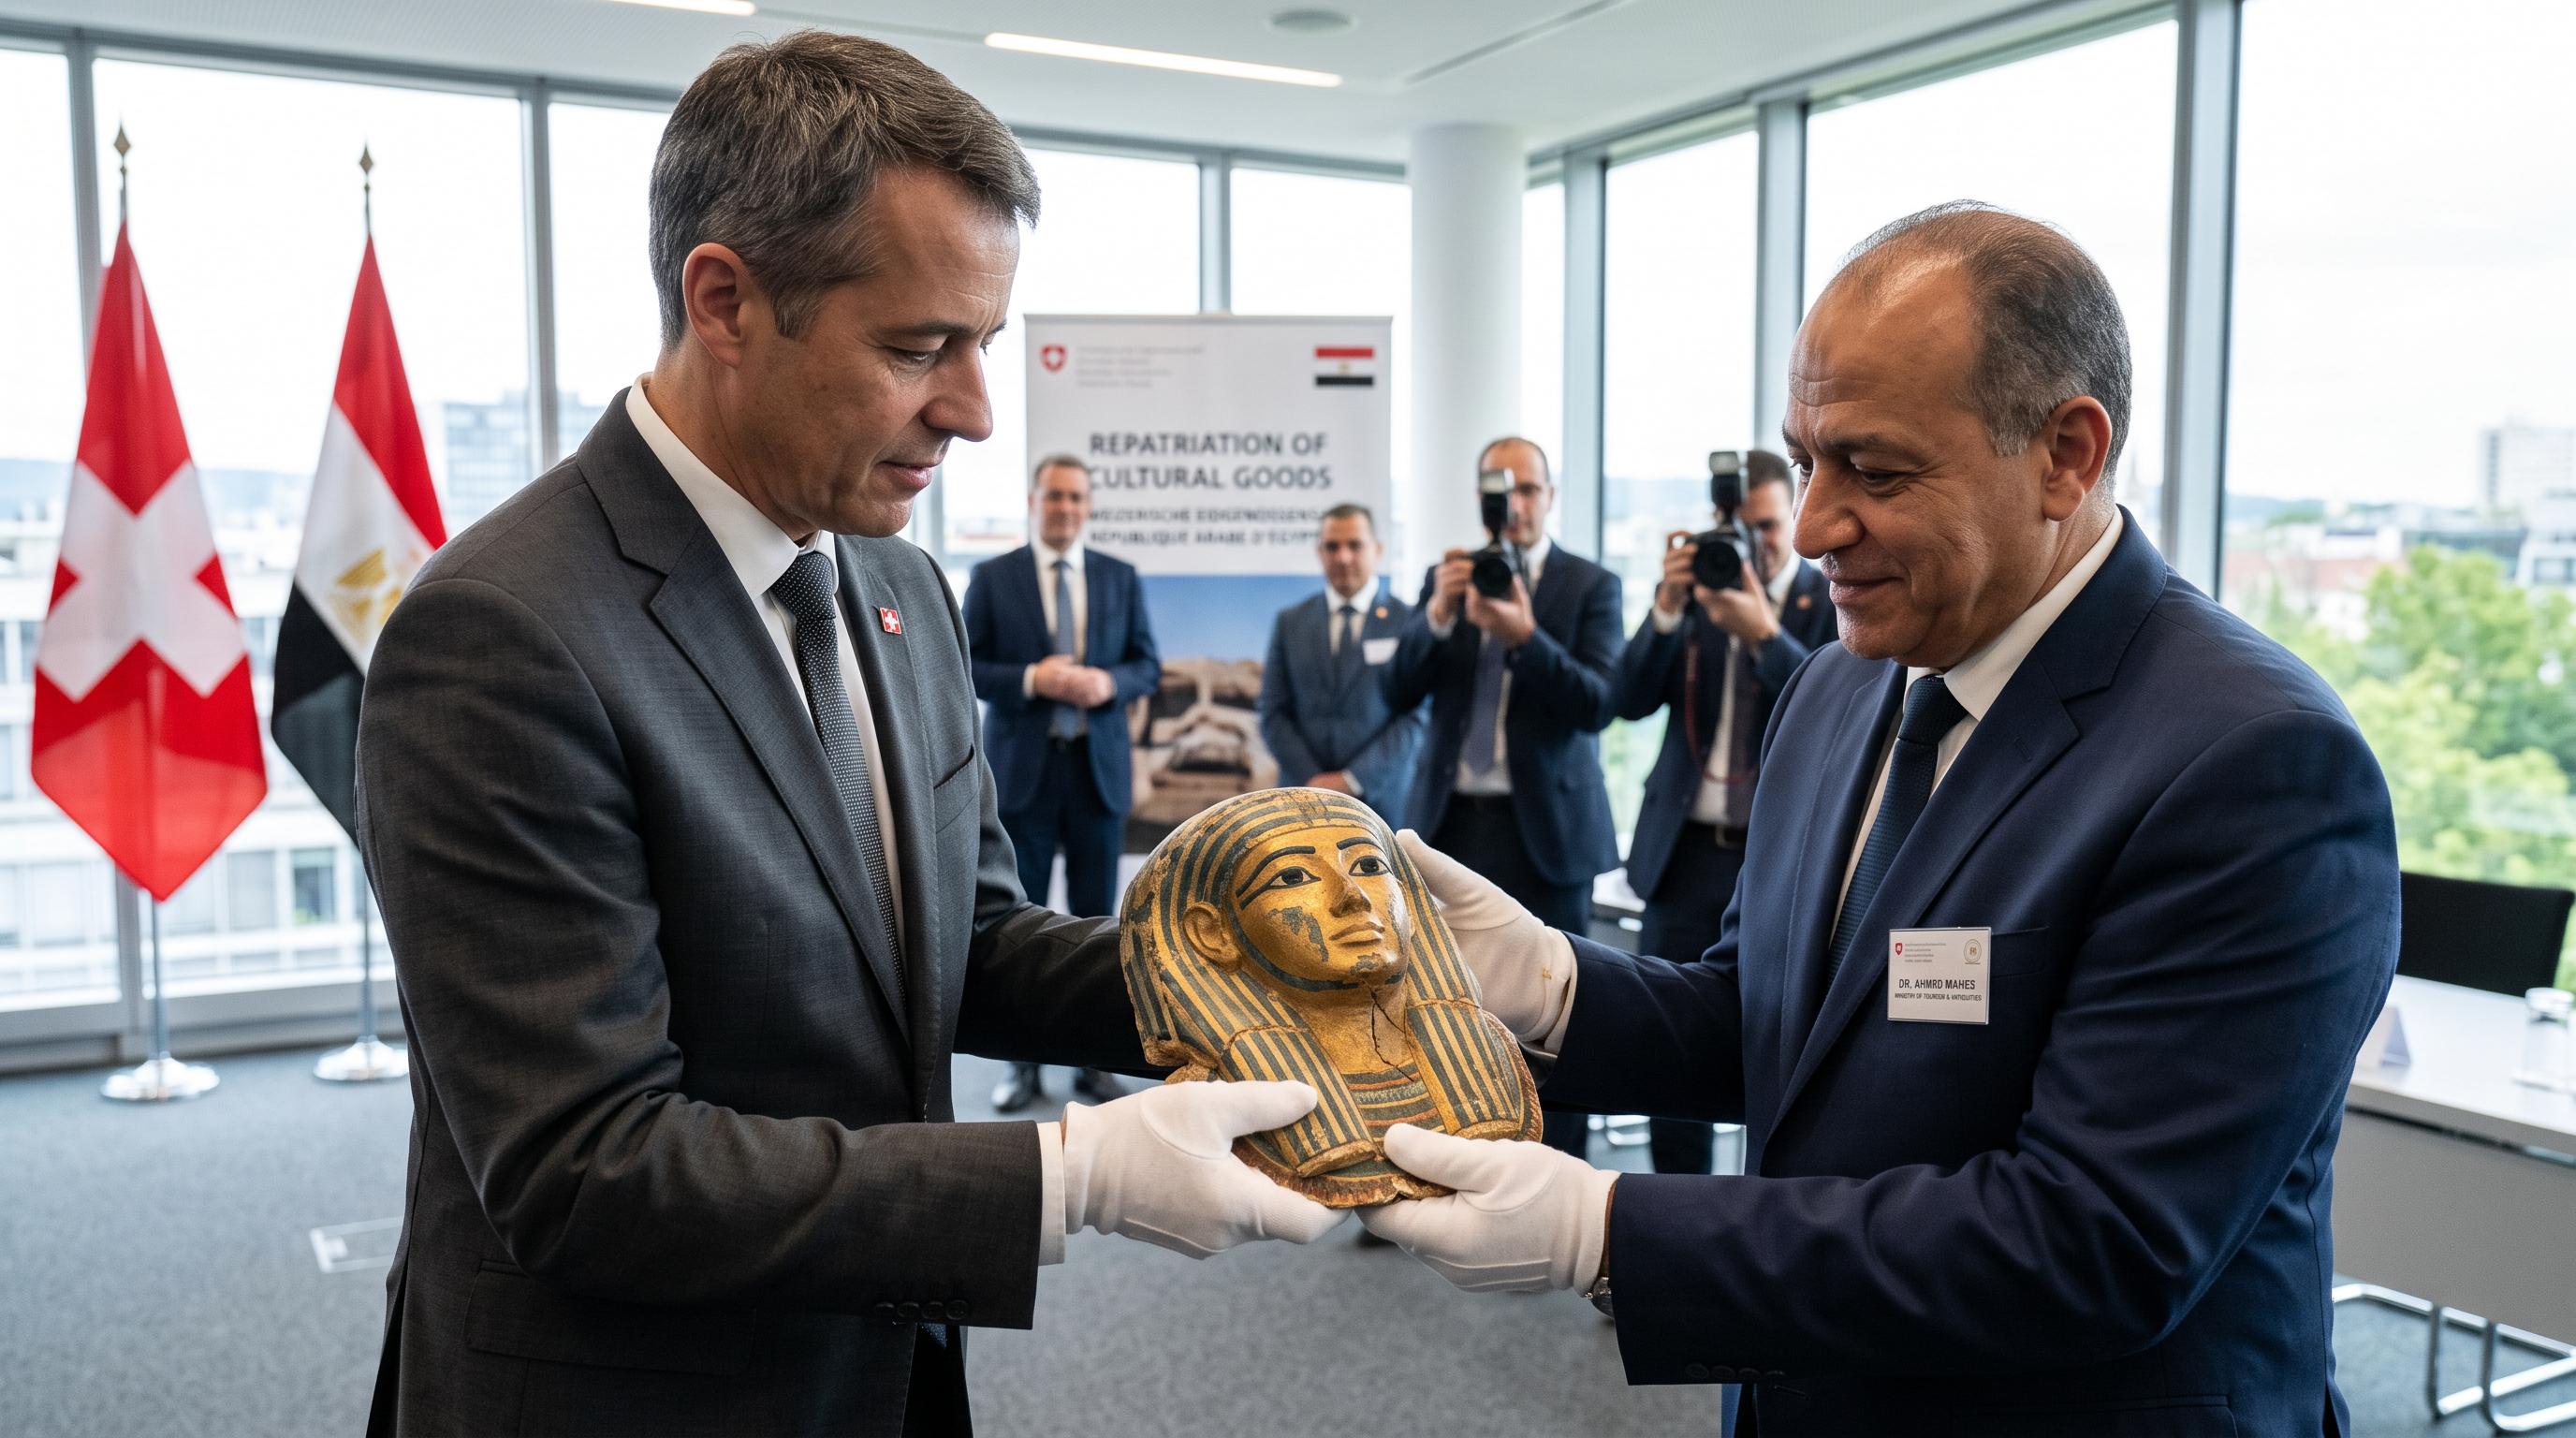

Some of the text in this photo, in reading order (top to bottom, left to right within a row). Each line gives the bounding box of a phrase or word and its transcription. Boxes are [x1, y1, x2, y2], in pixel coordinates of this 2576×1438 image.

[1089, 433, 1327, 455] REPATRIATION OF
[1090, 466, 1333, 490] CULTURAL GOODS
[1898, 978, 1976, 990] DR. AHMRD MAHES
